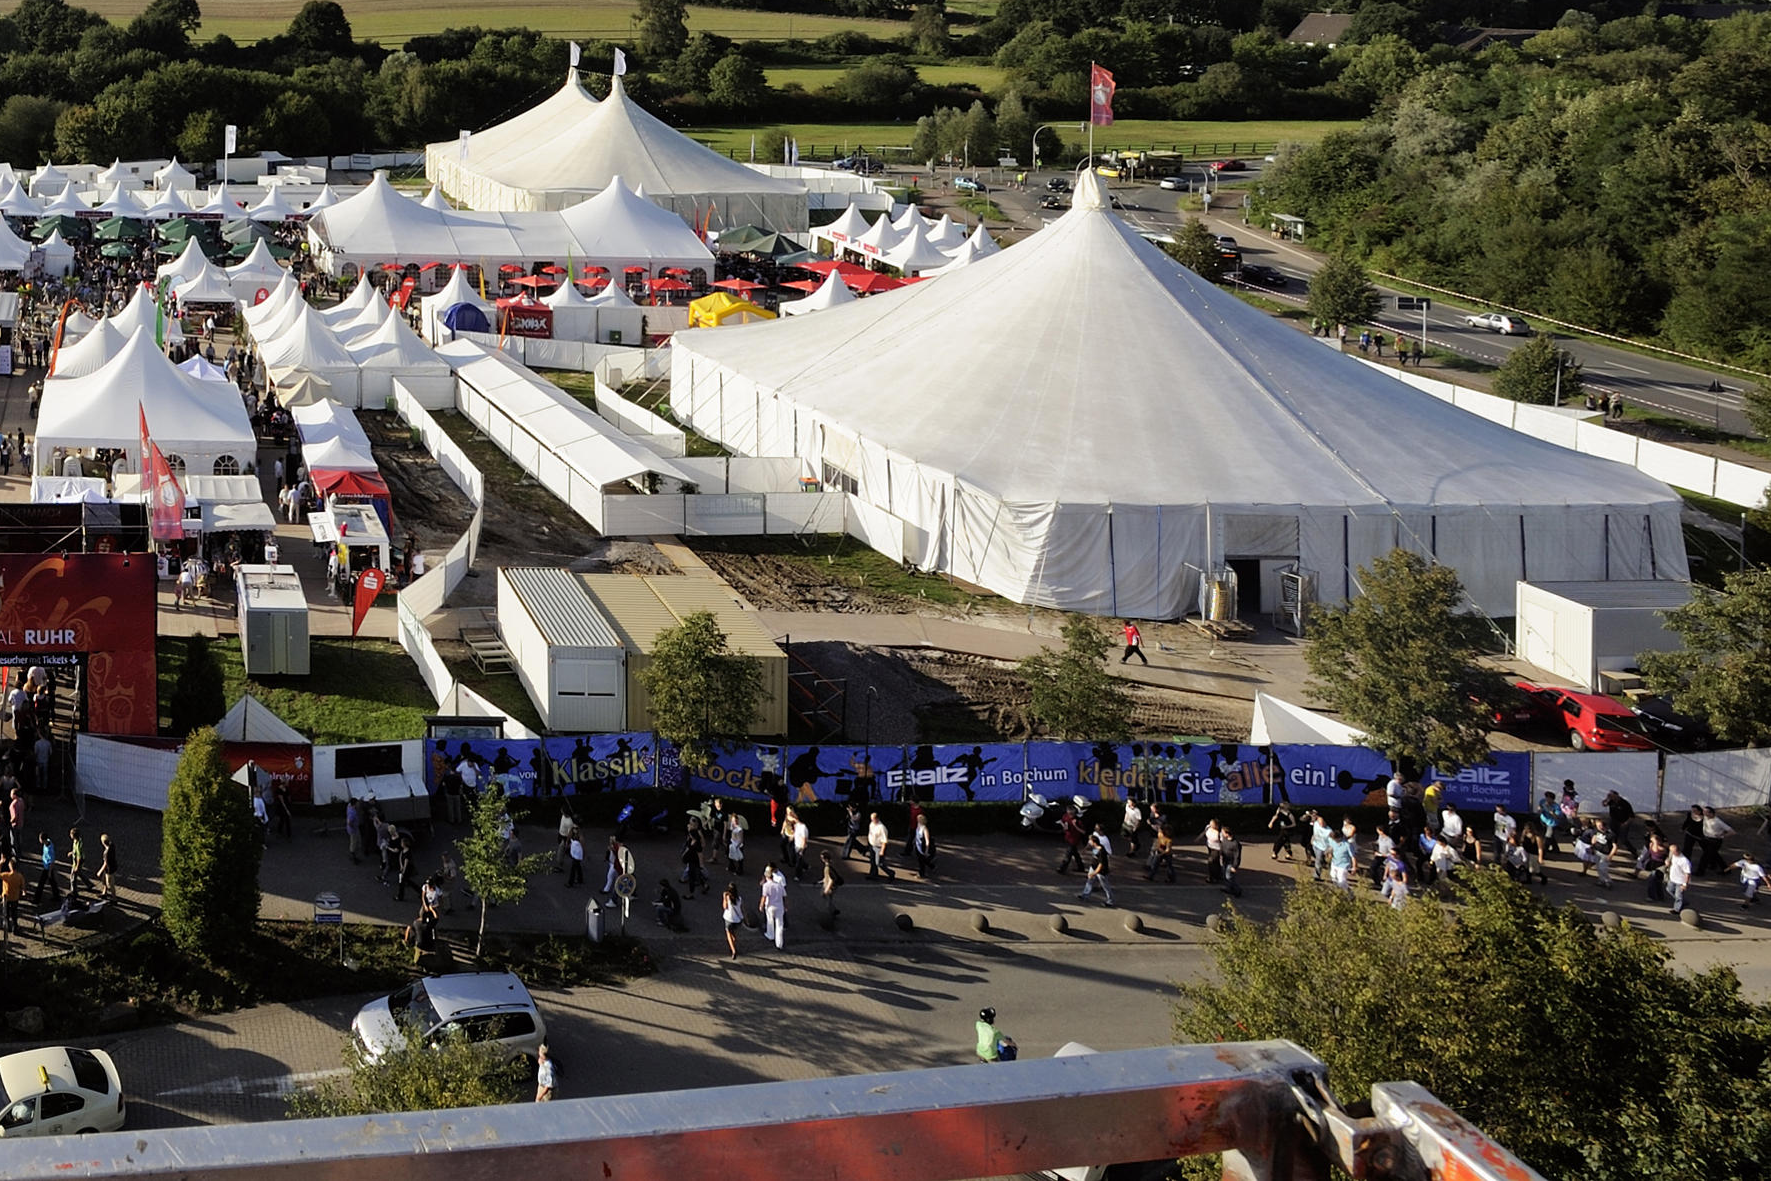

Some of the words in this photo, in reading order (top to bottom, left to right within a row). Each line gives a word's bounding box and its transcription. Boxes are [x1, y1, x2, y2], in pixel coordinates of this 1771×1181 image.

[24, 629, 76, 645] RUHR
[29, 656, 41, 664] mit
[42, 655, 68, 664] Tickets
[519, 771, 538, 780] VON
[552, 750, 648, 786] Klassik
[661, 756, 679, 767] BIS
[887, 766, 968, 788] Baltz
[981, 772, 996, 787] in
[1002, 768, 1068, 785] Bochum
[1179, 771, 1215, 795] Sie
[1228, 761, 1282, 792] alle
[1290, 763, 1337, 788] ein!
[1459, 784, 1469, 793] in
[1471, 784, 1511, 796] Bochum
